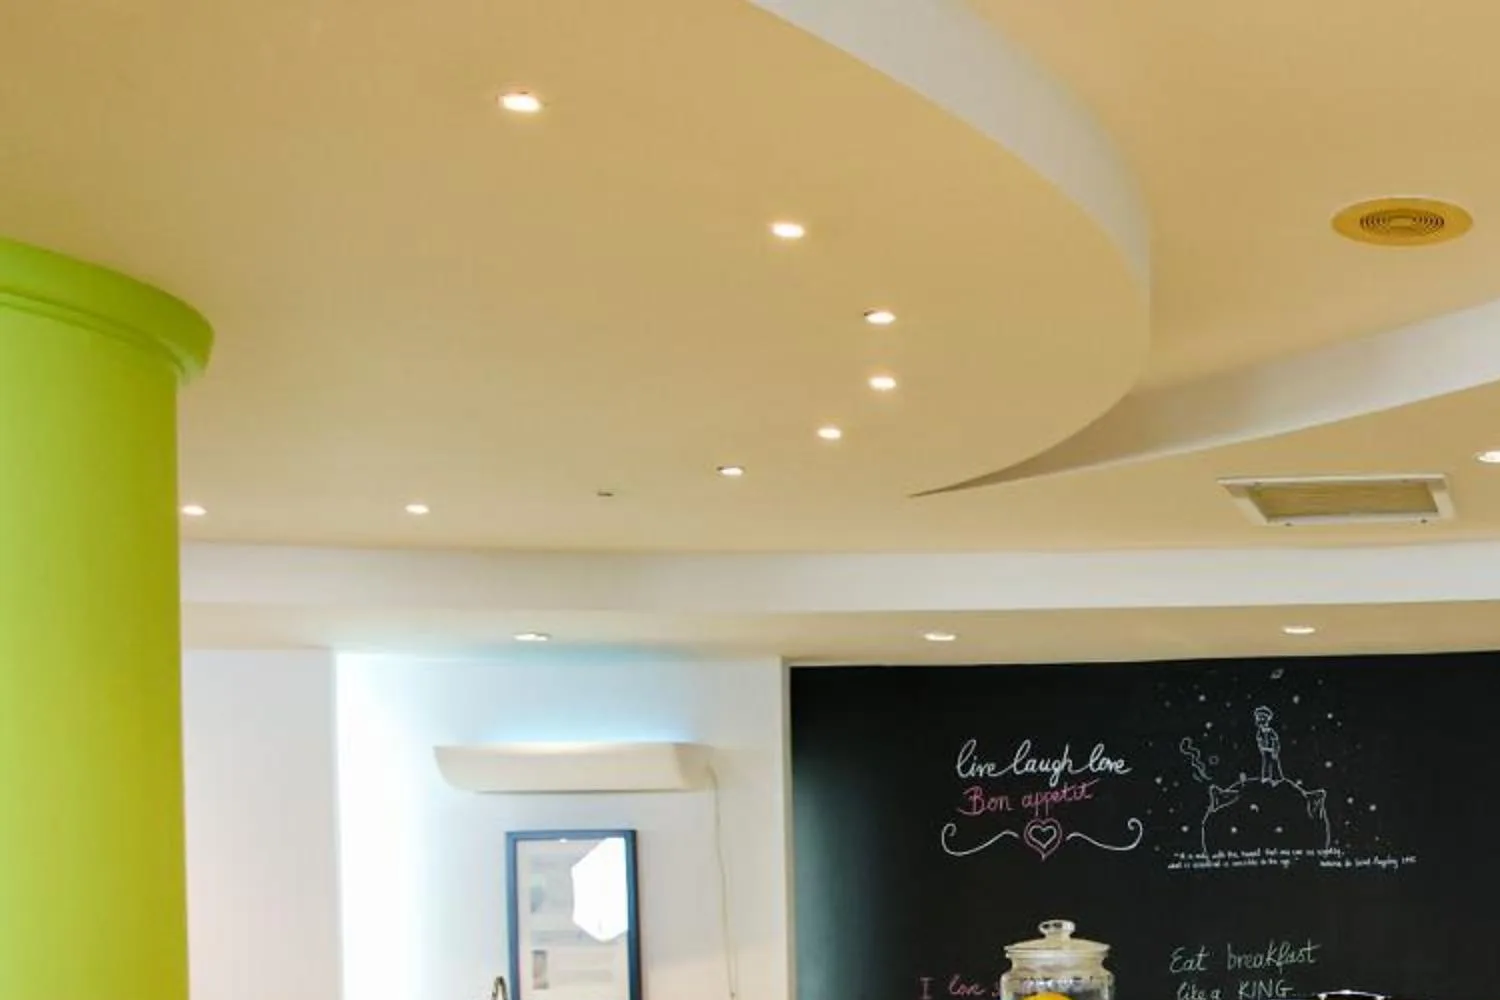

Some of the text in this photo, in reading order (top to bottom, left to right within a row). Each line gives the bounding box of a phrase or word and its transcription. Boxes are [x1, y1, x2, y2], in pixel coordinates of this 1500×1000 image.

[957, 739, 1132, 787] live laugh love
[957, 778, 1099, 816] Bon appetit
[1169, 938, 1321, 974] Eat breakfast
[920, 974, 984, 1000] I love
[1211, 989, 1222, 1000] a
